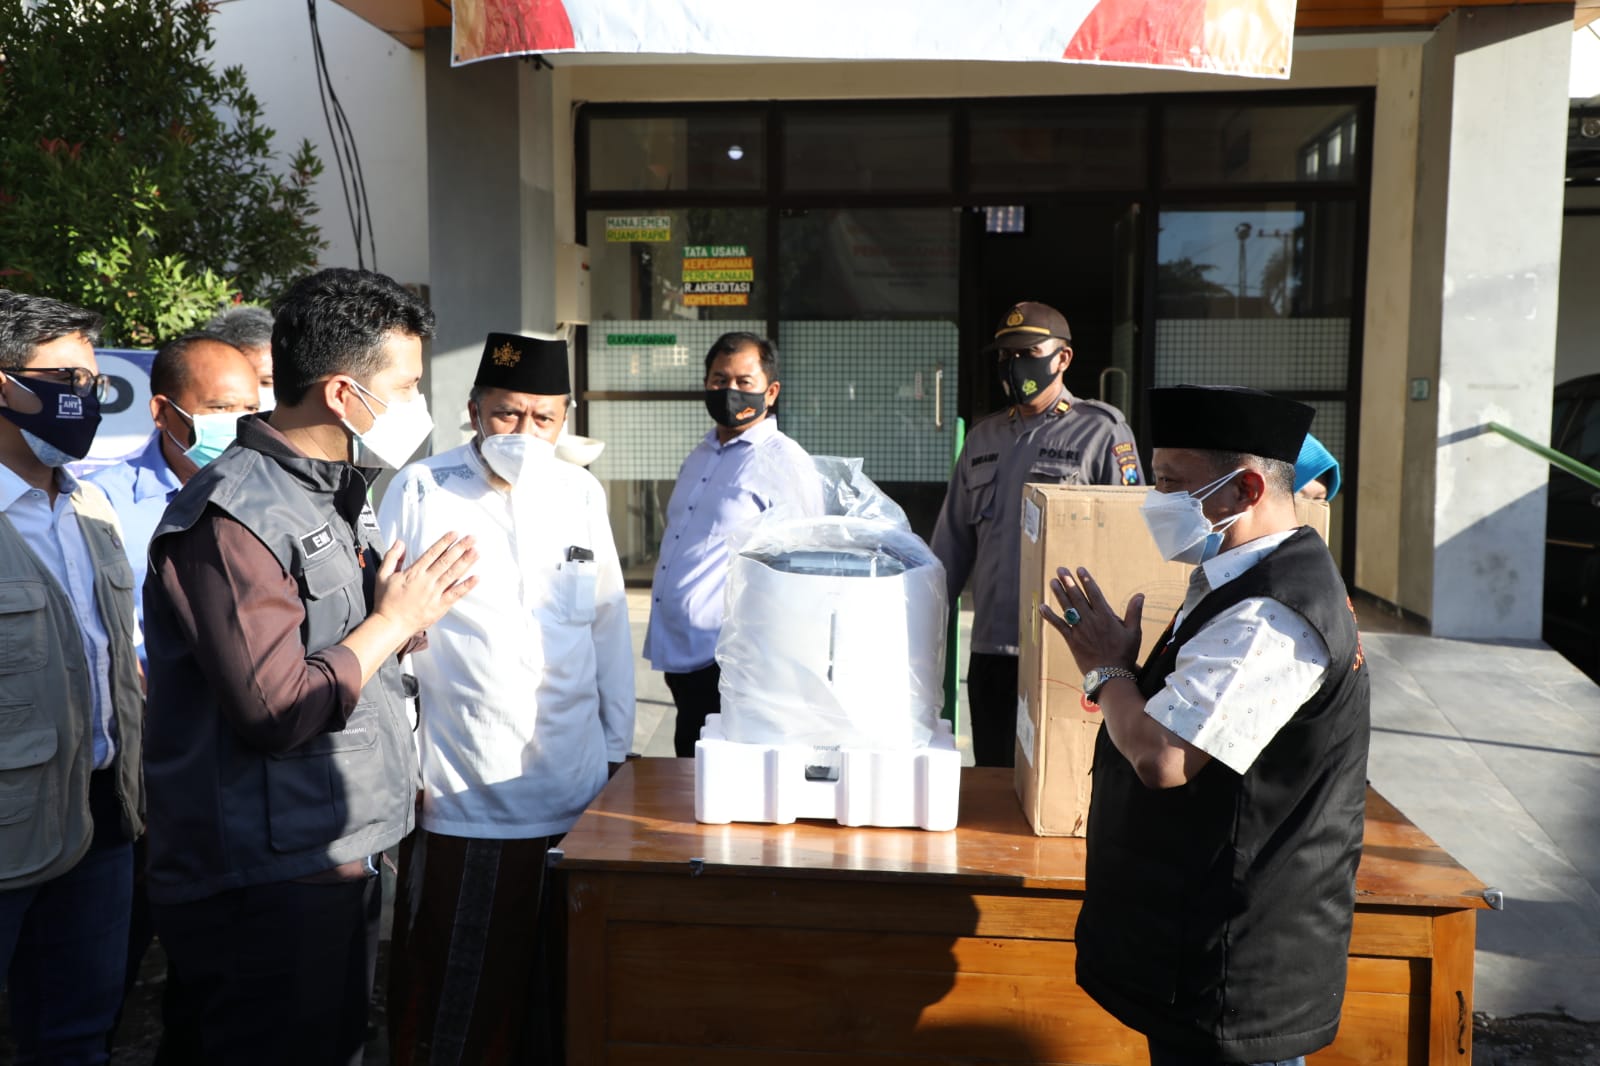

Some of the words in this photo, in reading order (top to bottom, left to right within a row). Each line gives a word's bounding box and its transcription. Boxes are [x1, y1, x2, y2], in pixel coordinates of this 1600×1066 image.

[607, 217, 670, 228] MANAJEMEN
[684, 246, 708, 257] TATA
[711, 246, 746, 257] USAHA
[1039, 448, 1080, 461] POLRI
